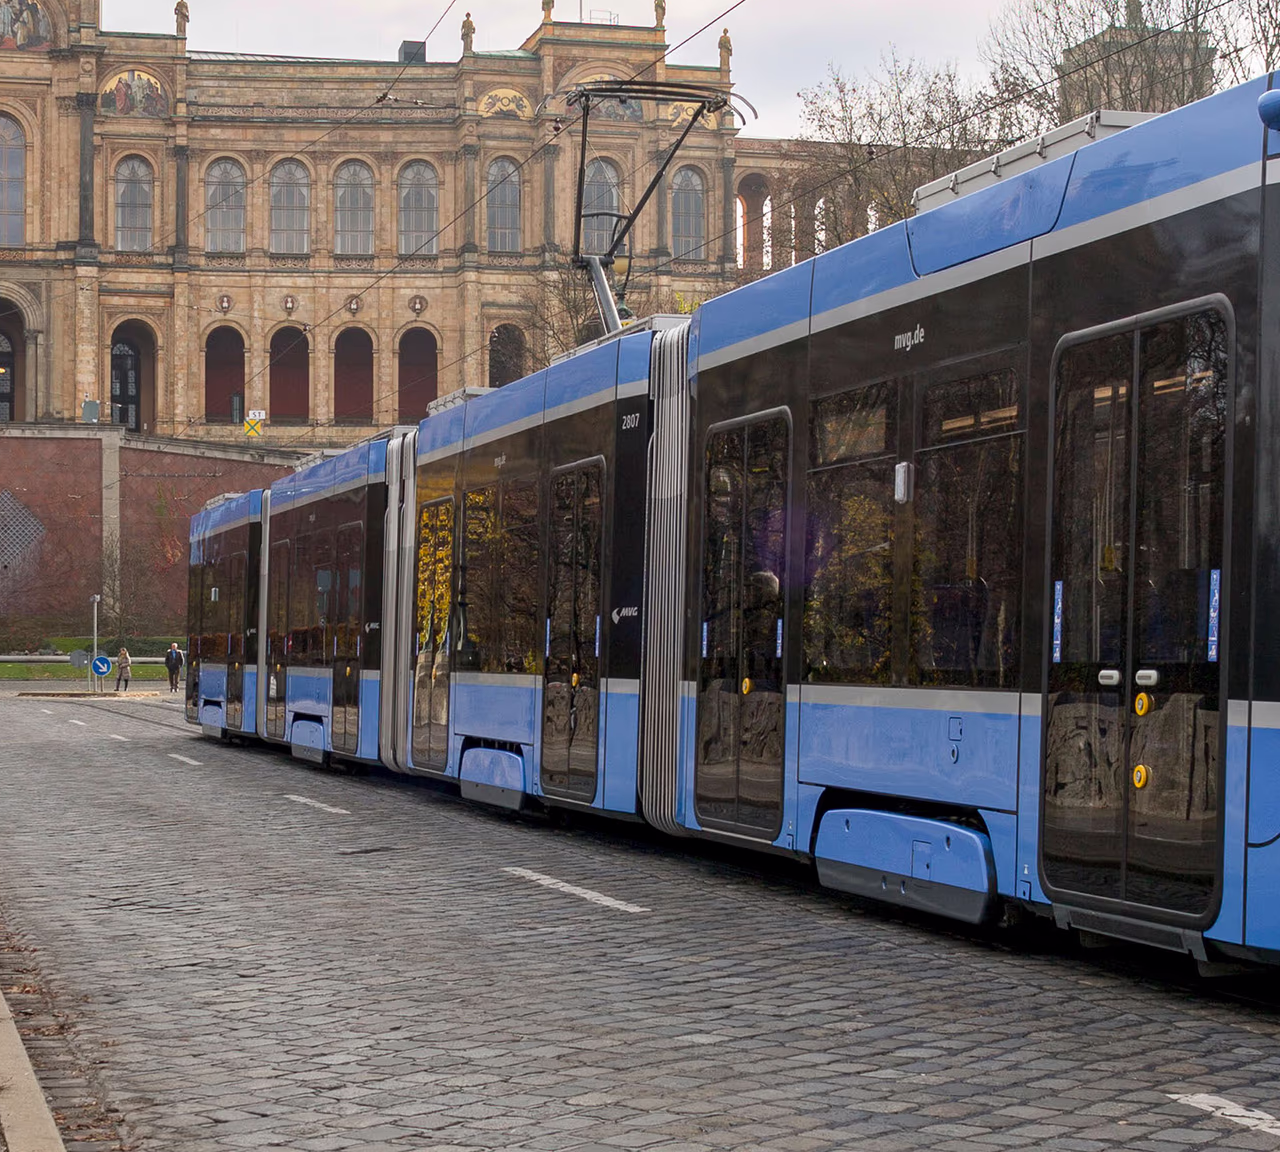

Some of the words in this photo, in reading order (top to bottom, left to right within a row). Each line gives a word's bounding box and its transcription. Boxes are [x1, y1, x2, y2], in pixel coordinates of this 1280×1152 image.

[894, 323, 925, 351] mvg.de
[621, 412, 640, 430] 2807
[619, 606, 638, 617] MVG
